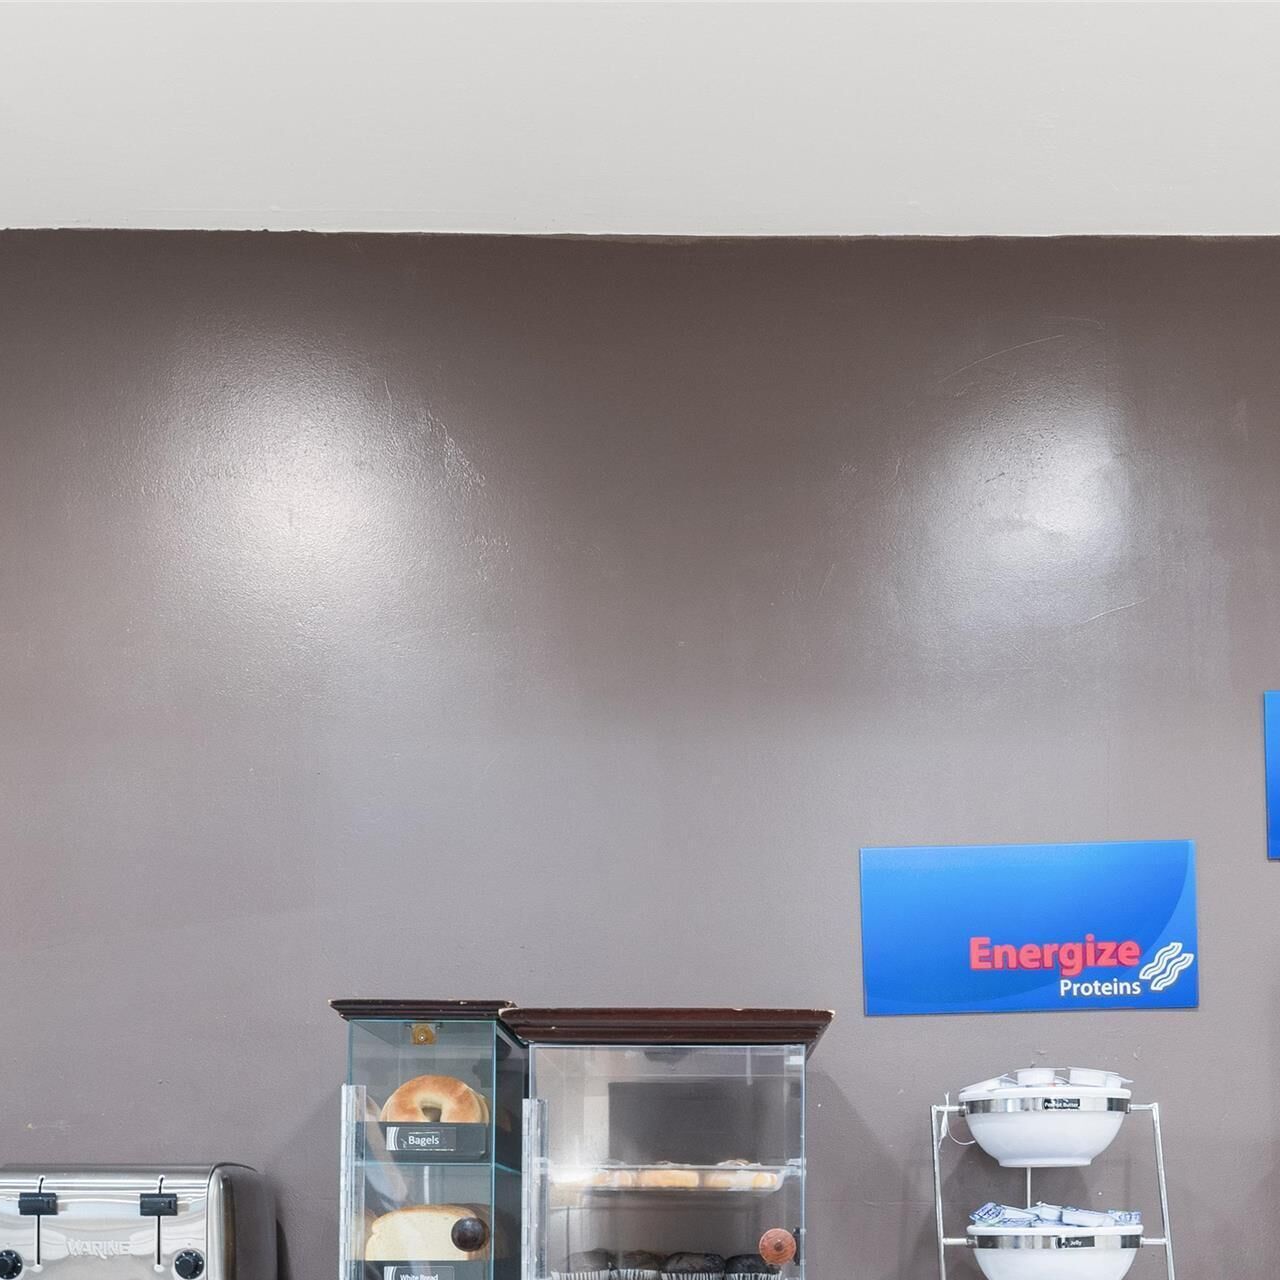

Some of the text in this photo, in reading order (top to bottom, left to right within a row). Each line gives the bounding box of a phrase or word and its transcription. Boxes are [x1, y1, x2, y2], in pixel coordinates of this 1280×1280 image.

[969, 933, 1142, 977] Energize
[1059, 978, 1142, 997] Proteins
[408, 1135, 440, 1146] Bagels
